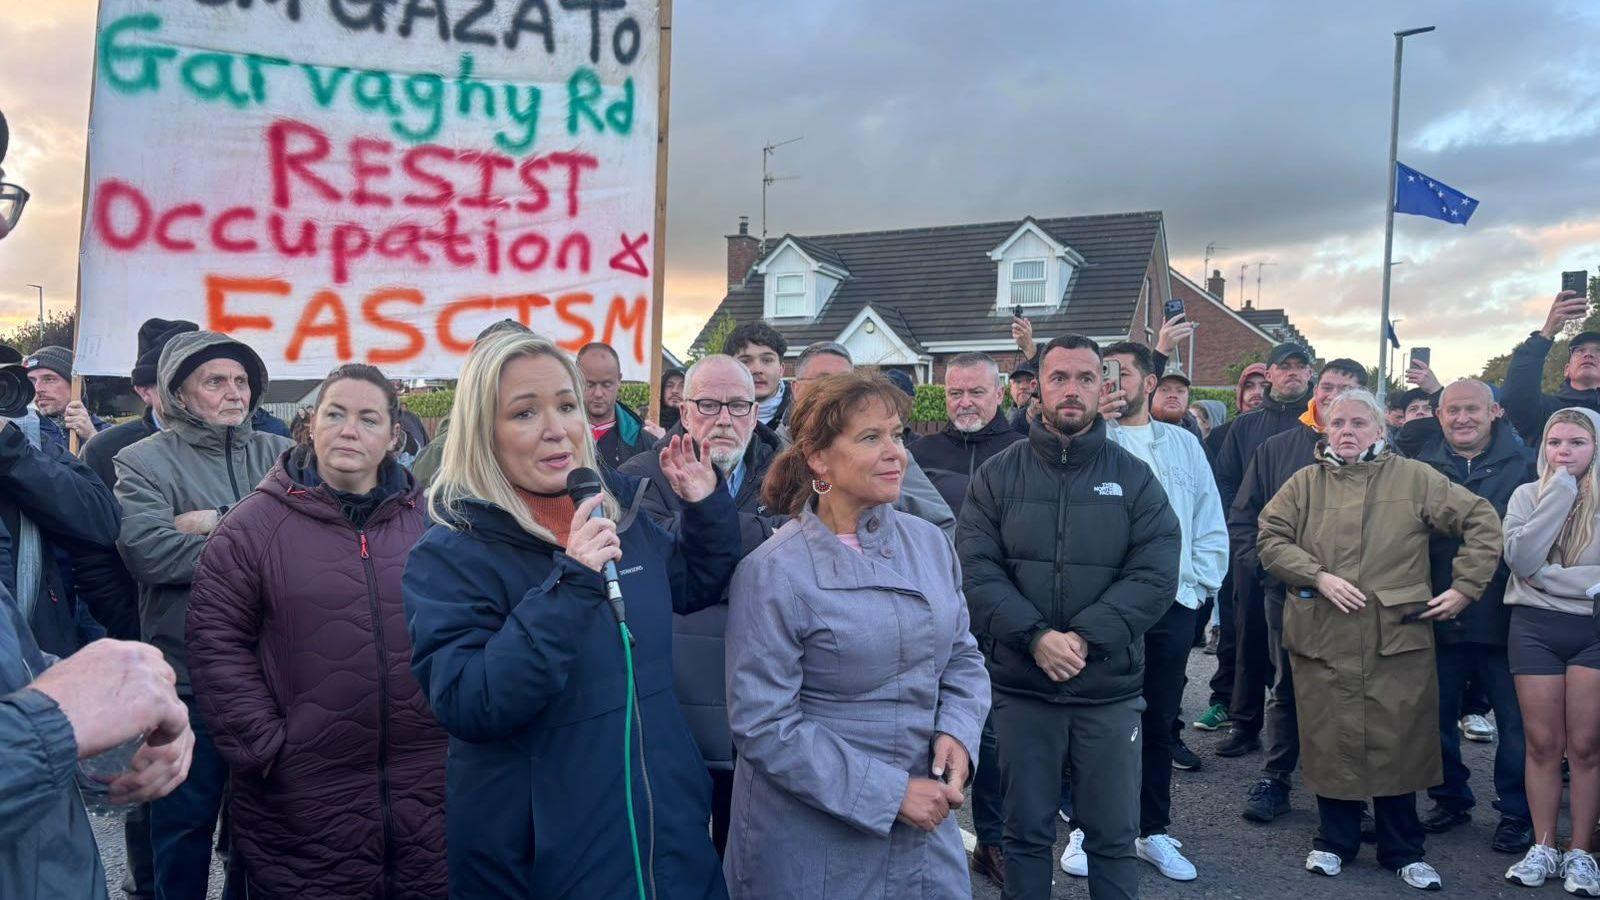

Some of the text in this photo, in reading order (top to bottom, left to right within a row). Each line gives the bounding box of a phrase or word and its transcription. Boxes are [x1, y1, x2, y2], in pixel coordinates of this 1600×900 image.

[328, 0, 556, 54] GAZA
[98, 12, 636, 155] Garvaghy Rd
[266, 120, 599, 217] RESIST
[93, 179, 592, 285] Occupation
